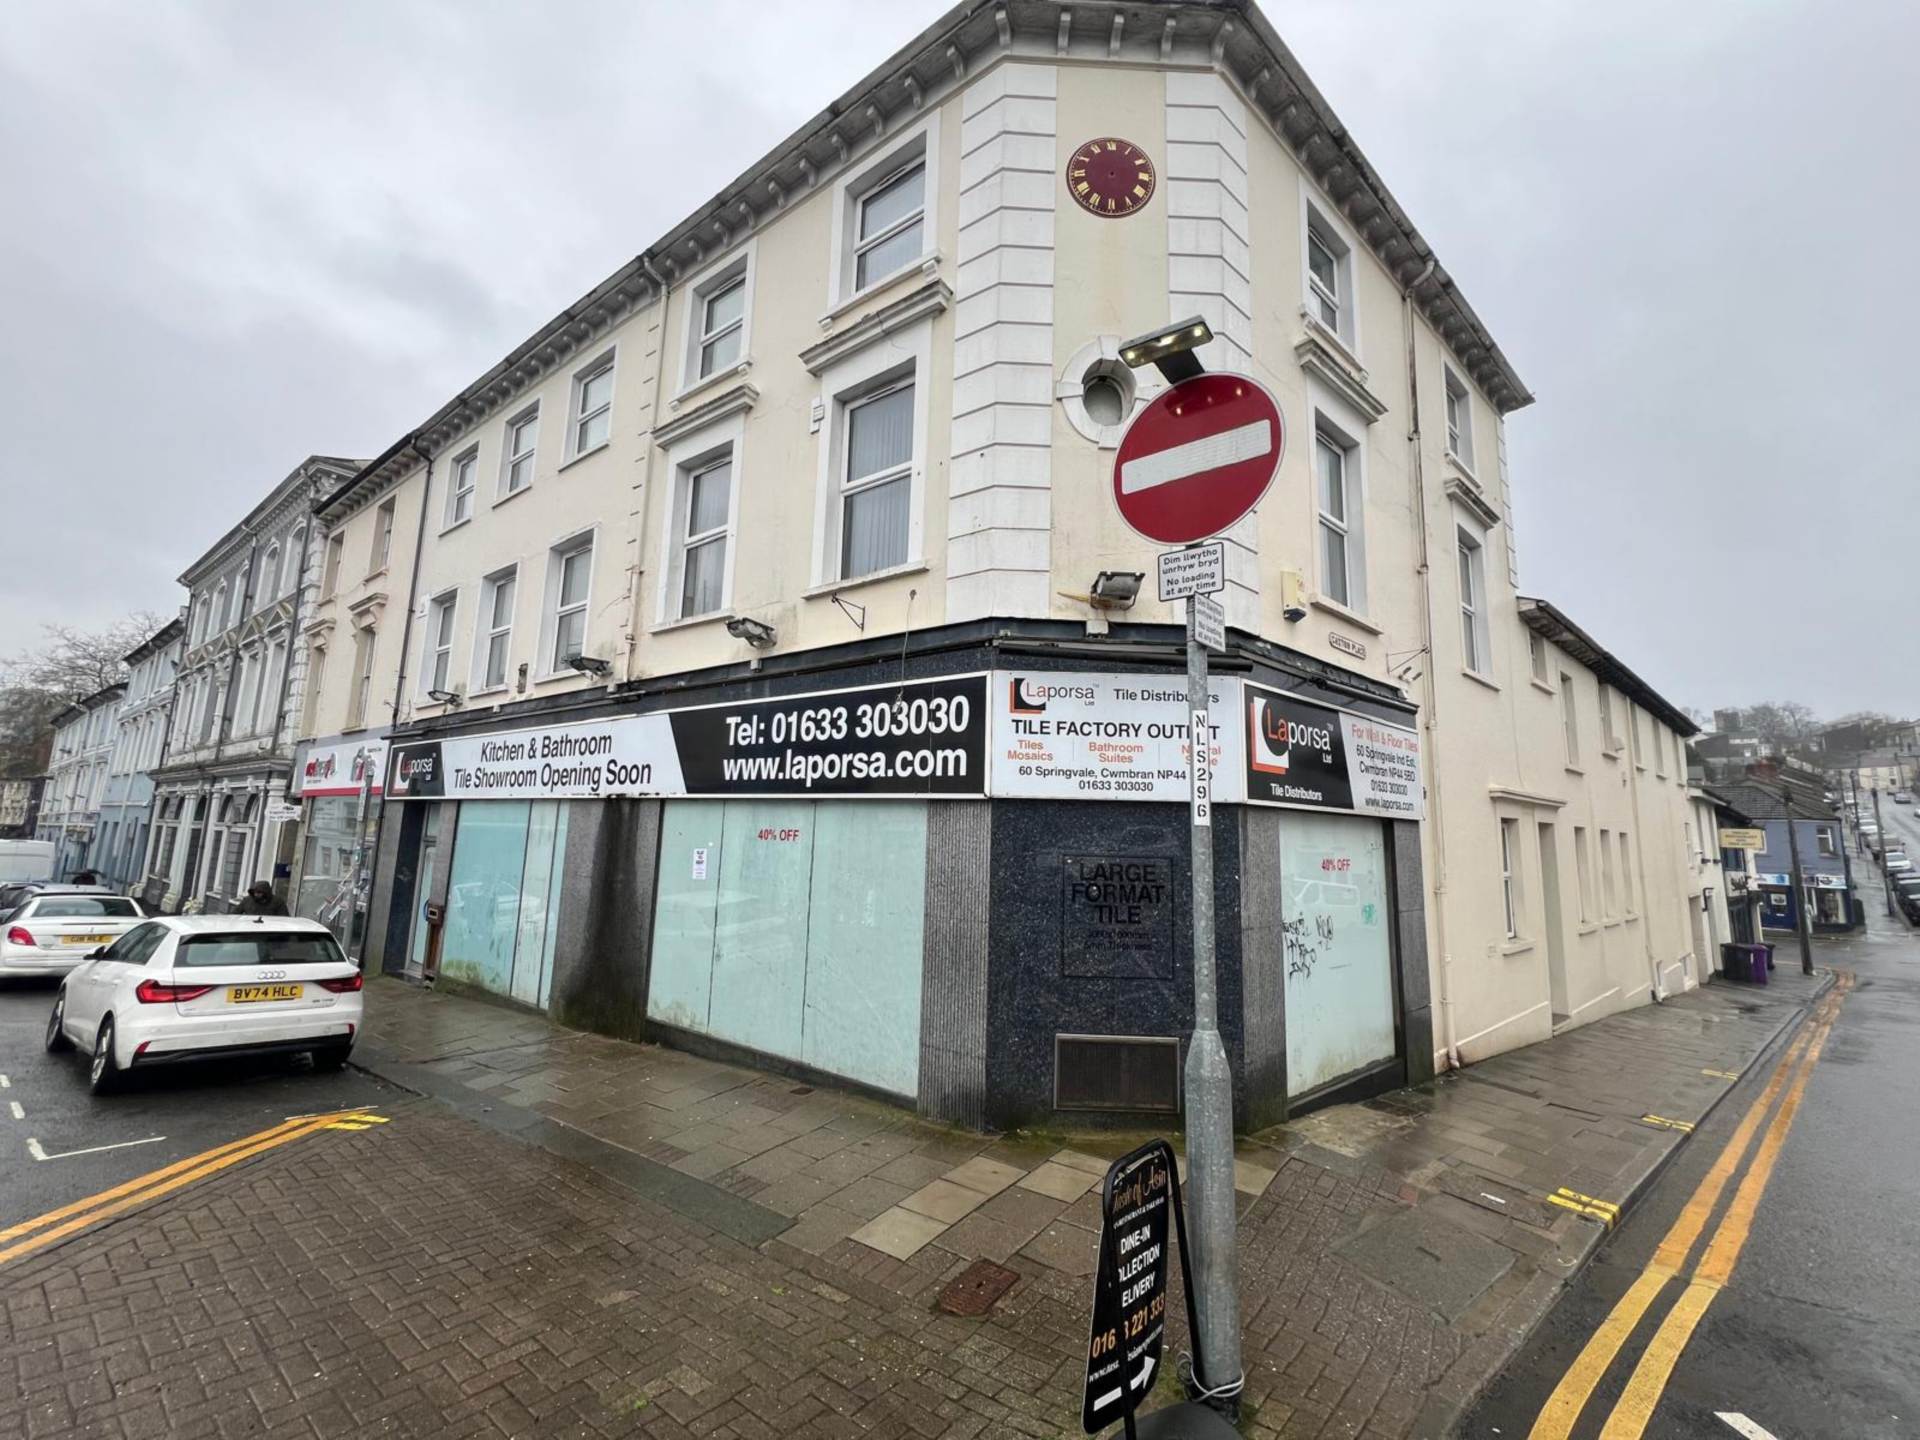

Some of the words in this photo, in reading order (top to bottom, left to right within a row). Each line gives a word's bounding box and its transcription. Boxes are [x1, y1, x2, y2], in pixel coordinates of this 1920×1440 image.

[1162, 563, 1195, 575] unrhyw
[1198, 557, 1219, 568] bryd
[1163, 556, 1181, 566] Dim
[1183, 549, 1218, 561] llwytho
[1165, 588, 1176, 596] at
[1177, 585, 1194, 594] any
[1196, 580, 1217, 590] time
[1166, 578, 1180, 587] No
[1182, 572, 1216, 584] loading
[1026, 681, 1095, 701] Laporsa
[1113, 688, 1138, 701] Tile
[1141, 689, 1220, 703] Distriburs
[726, 714, 765, 746] Tel:
[771, 706, 848, 744] 01633
[855, 695, 970, 738] 303030
[1267, 707, 1331, 751] Laporsa
[1011, 719, 1051, 735] TILE
[1056, 721, 1142, 738] FACTORY
[1147, 724, 1220, 740] OUTLT
[1351, 723, 1364, 738] For
[480, 741, 525, 762] Kitchen
[528, 737, 537, 758] &
[541, 733, 612, 759] Bathroom
[1018, 740, 1044, 750] Tiles
[1088, 741, 1144, 753] Bathroom
[1181, 744, 1221, 756] Nral
[1008, 750, 1054, 761] Mosaics
[1098, 753, 1134, 763] Suites
[1322, 752, 1333, 764] Ltd
[454, 767, 472, 789] Tile
[474, 766, 537, 788] Showroom
[541, 761, 600, 792] Opening
[605, 759, 652, 786] Soon
[723, 747, 967, 788] www.laporsa.com
[1018, 766, 1032, 776] 60
[1035, 765, 1097, 780] Springvale,
[1100, 768, 1154, 780] Cwmbran
[1157, 769, 1187, 780] NP44
[1079, 780, 1111, 790] 01633
[1114, 781, 1154, 792] 303030
[1270, 783, 1284, 797] Tile
[1285, 784, 1323, 801] Distributors
[757, 828, 777, 841] 40%
[779, 829, 799, 842] OFF
[1080, 863, 1156, 882] LARGE
[1321, 859, 1336, 871] 40%
[1336, 859, 1351, 872] OFF
[1071, 883, 1165, 904] FORMAT
[1095, 905, 1142, 924] TILE
[233, 987, 268, 999] BV74
[272, 985, 298, 997] HLC
[1120, 1224, 1151, 1255] DINE-IN
[1118, 1242, 1160, 1282] LLECTION
[1122, 1271, 1156, 1308] ELIVERY
[1131, 1305, 1148, 1337] 221
